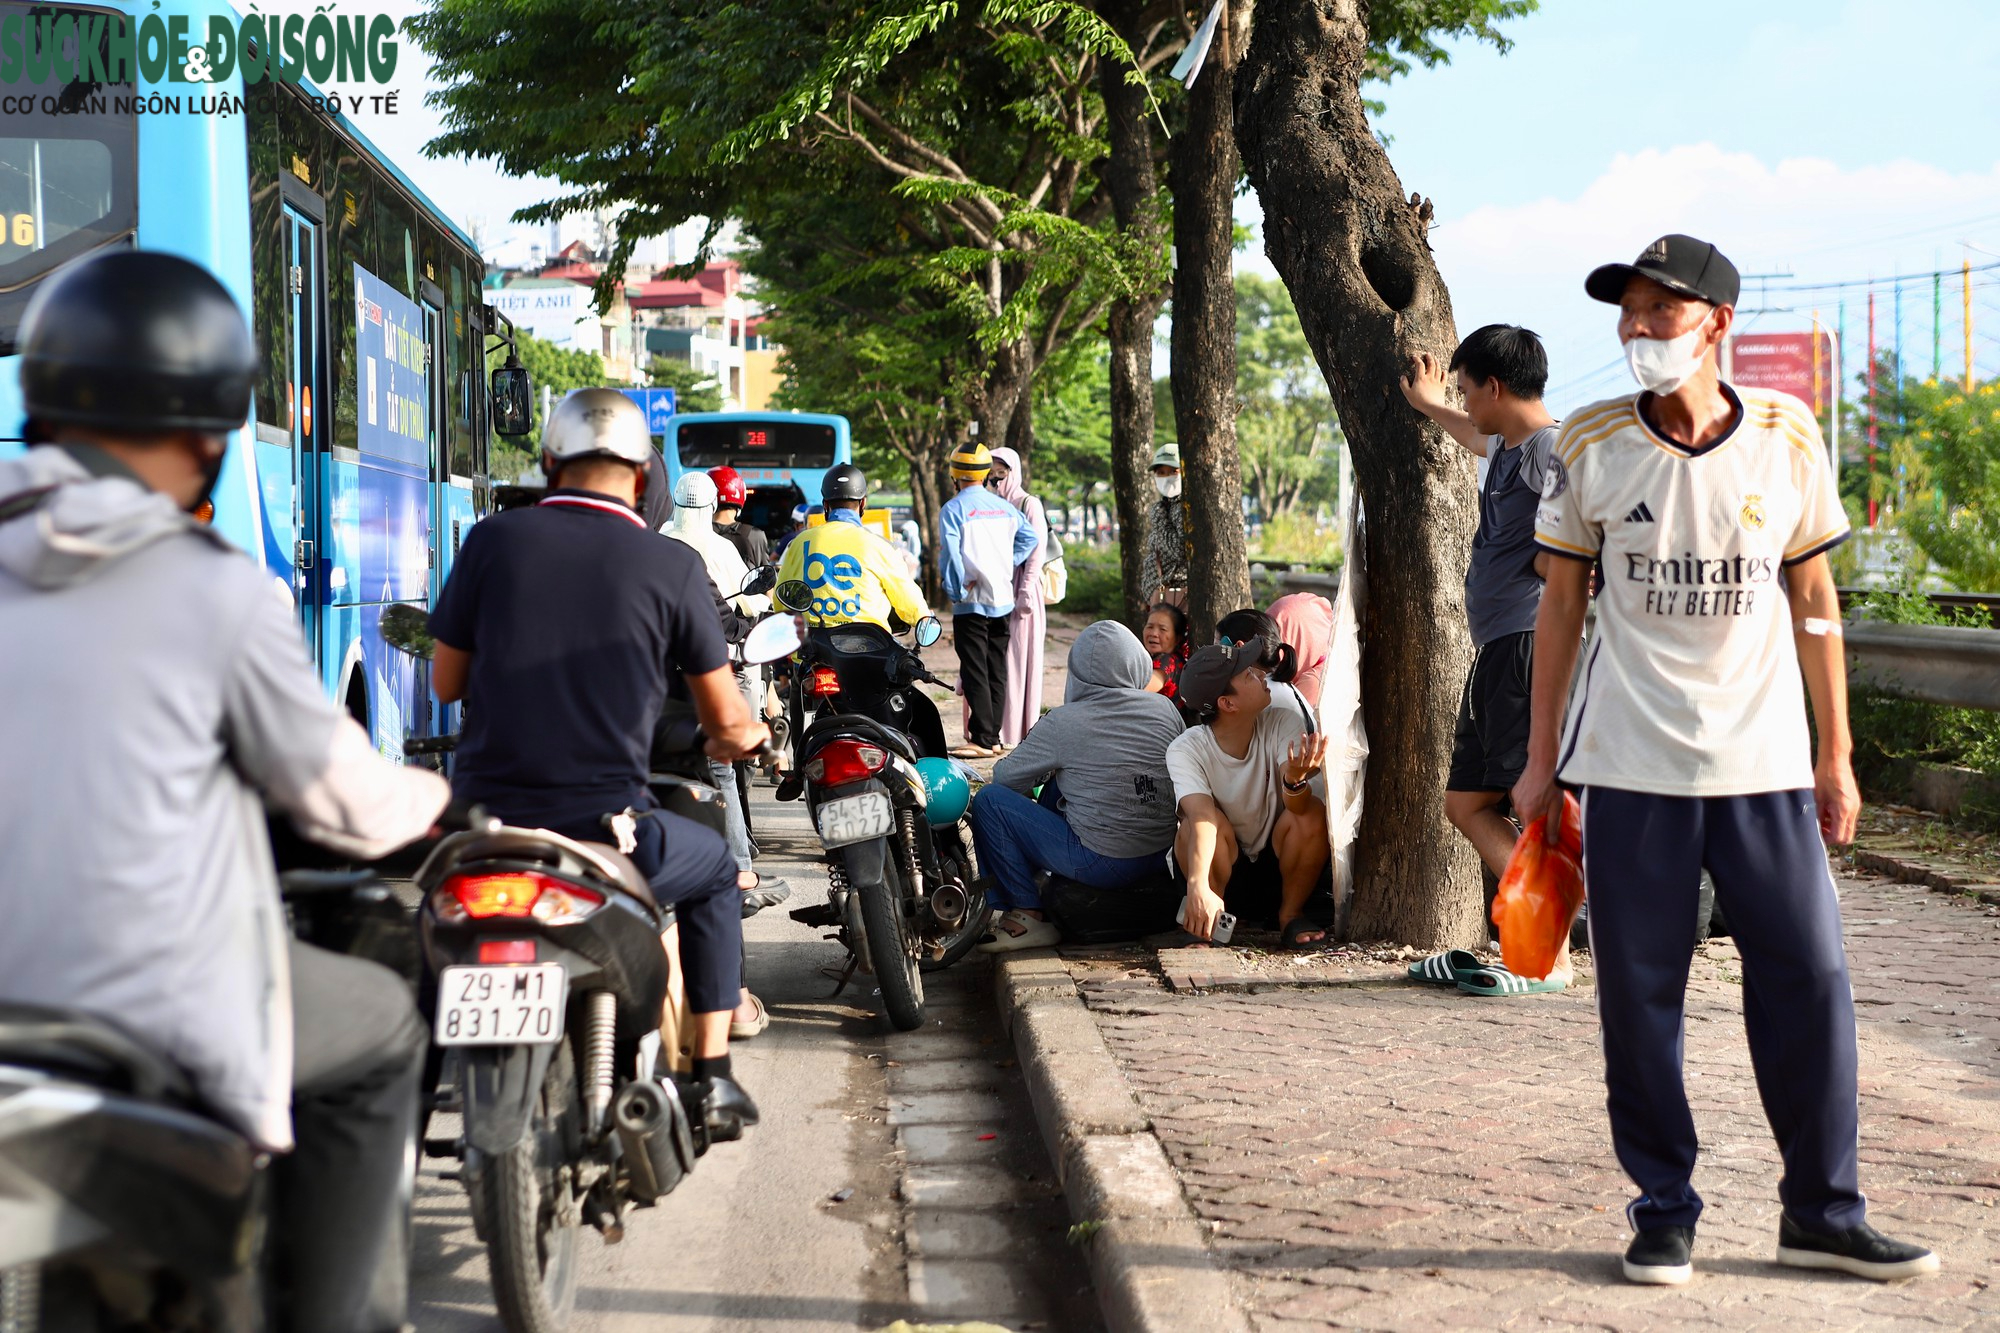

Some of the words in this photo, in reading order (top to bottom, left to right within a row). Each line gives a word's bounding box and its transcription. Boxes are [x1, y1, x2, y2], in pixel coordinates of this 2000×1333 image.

[0, 213, 35, 247] 6
[536, 295, 571, 307] ANH
[748, 431, 767, 445] 28
[803, 540, 862, 591] be
[1624, 552, 1772, 585] Emirates
[809, 594, 861, 617] ood
[1646, 590, 1677, 615] FLY
[1685, 590, 1755, 616] BETTER
[828, 794, 881, 822] 54-F2
[446, 1007, 552, 1038] 831.70
